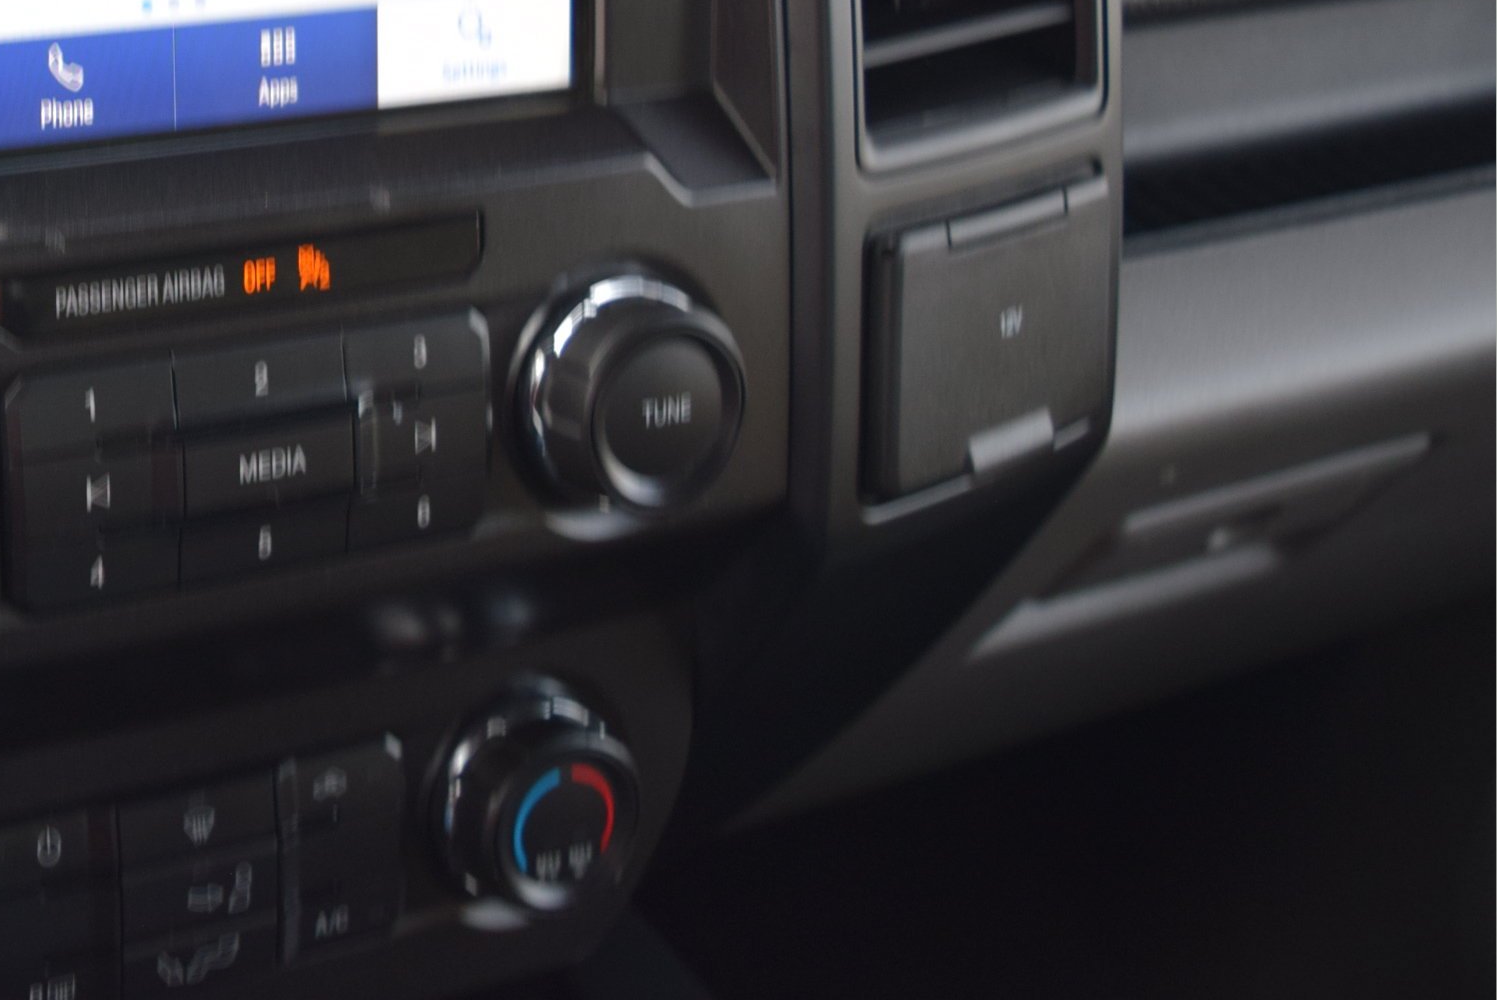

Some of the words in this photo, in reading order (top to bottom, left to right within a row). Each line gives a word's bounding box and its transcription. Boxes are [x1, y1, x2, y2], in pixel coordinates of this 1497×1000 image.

[259, 76, 299, 108] Apps
[41, 97, 94, 130] Phone
[55, 274, 159, 319] PASSENGER
[163, 264, 225, 304] AIRBAG
[243, 257, 276, 295] OFF
[642, 390, 692, 428] TUNE
[239, 444, 307, 485] MEDIA
